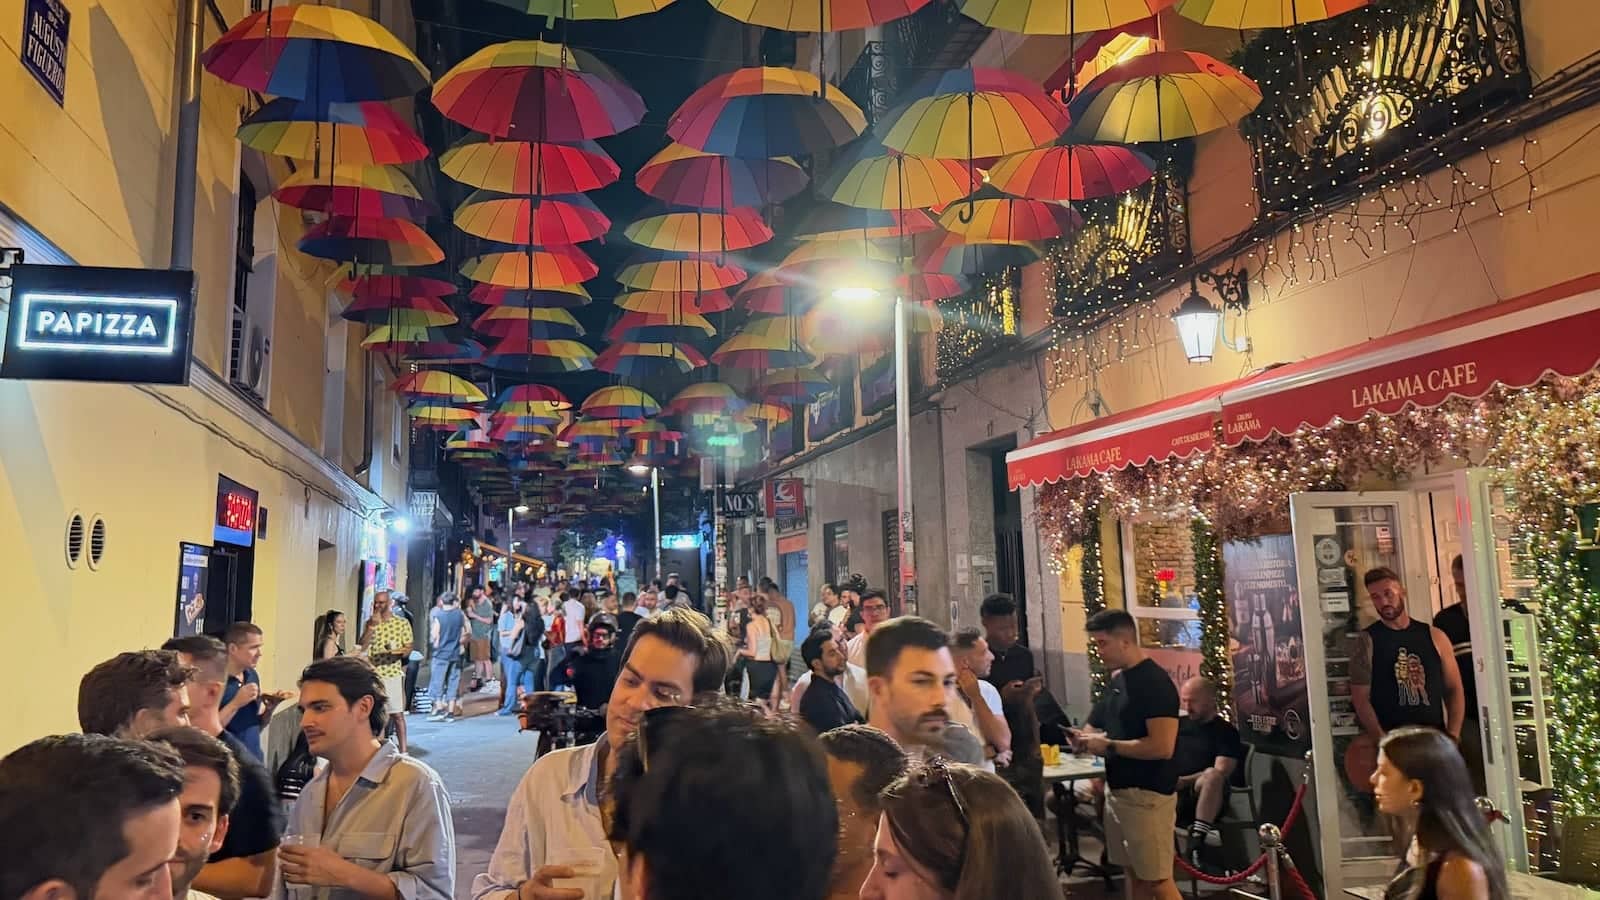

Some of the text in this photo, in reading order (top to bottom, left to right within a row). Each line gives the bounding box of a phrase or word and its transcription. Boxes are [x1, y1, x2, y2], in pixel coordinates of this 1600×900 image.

[38, 310, 157, 337] PAPIZZA
[1352, 361, 1478, 409] LAKAMA CAFE
[1227, 418, 1262, 434] LAKAMA
[1066, 446, 1122, 471] LAKAMA CAFE
